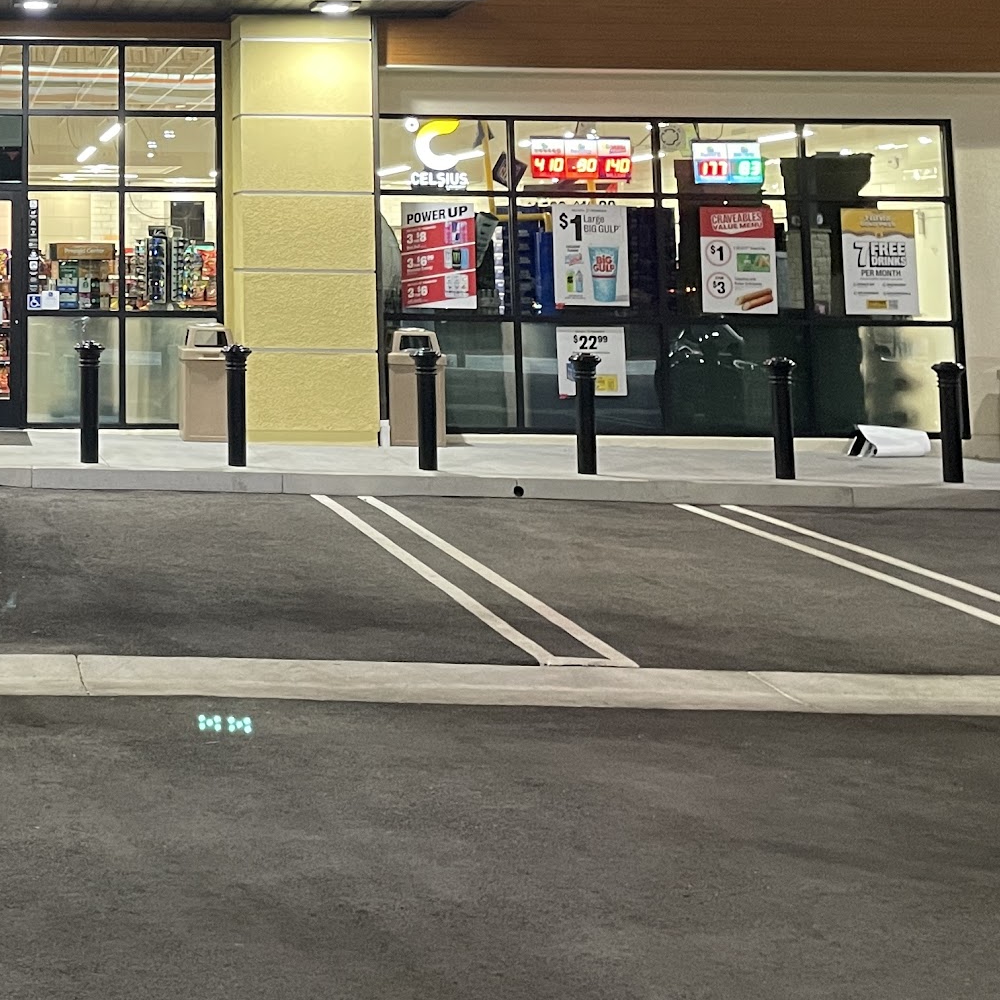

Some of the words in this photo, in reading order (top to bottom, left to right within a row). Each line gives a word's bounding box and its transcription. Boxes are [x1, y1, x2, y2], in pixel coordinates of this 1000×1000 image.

[605, 158, 631, 173] 140
[702, 161, 728, 176] 177
[410, 171, 469, 187] CELSIUS
[406, 209, 446, 224] POWER
[448, 206, 468, 217] UP
[583, 215, 605, 225] Large
[711, 212, 762, 225] CRAVEABLES
[559, 212, 582, 241] $1
[583, 225, 597, 233] BIG
[598, 225, 620, 234] GULP
[713, 222, 738, 230] VALUE
[739, 220, 763, 228] MENU
[406, 233, 414, 244] 3
[710, 244, 724, 261] $1
[853, 241, 870, 268] 7
[870, 241, 906, 257] FREE
[407, 257, 414, 269] 3
[596, 255, 612, 265] BIG
[870, 256, 908, 268] DRINKS
[593, 263, 615, 273] GULP
[861, 269, 875, 277] PER
[876, 269, 902, 277] MONTH
[712, 280, 726, 294] $3
